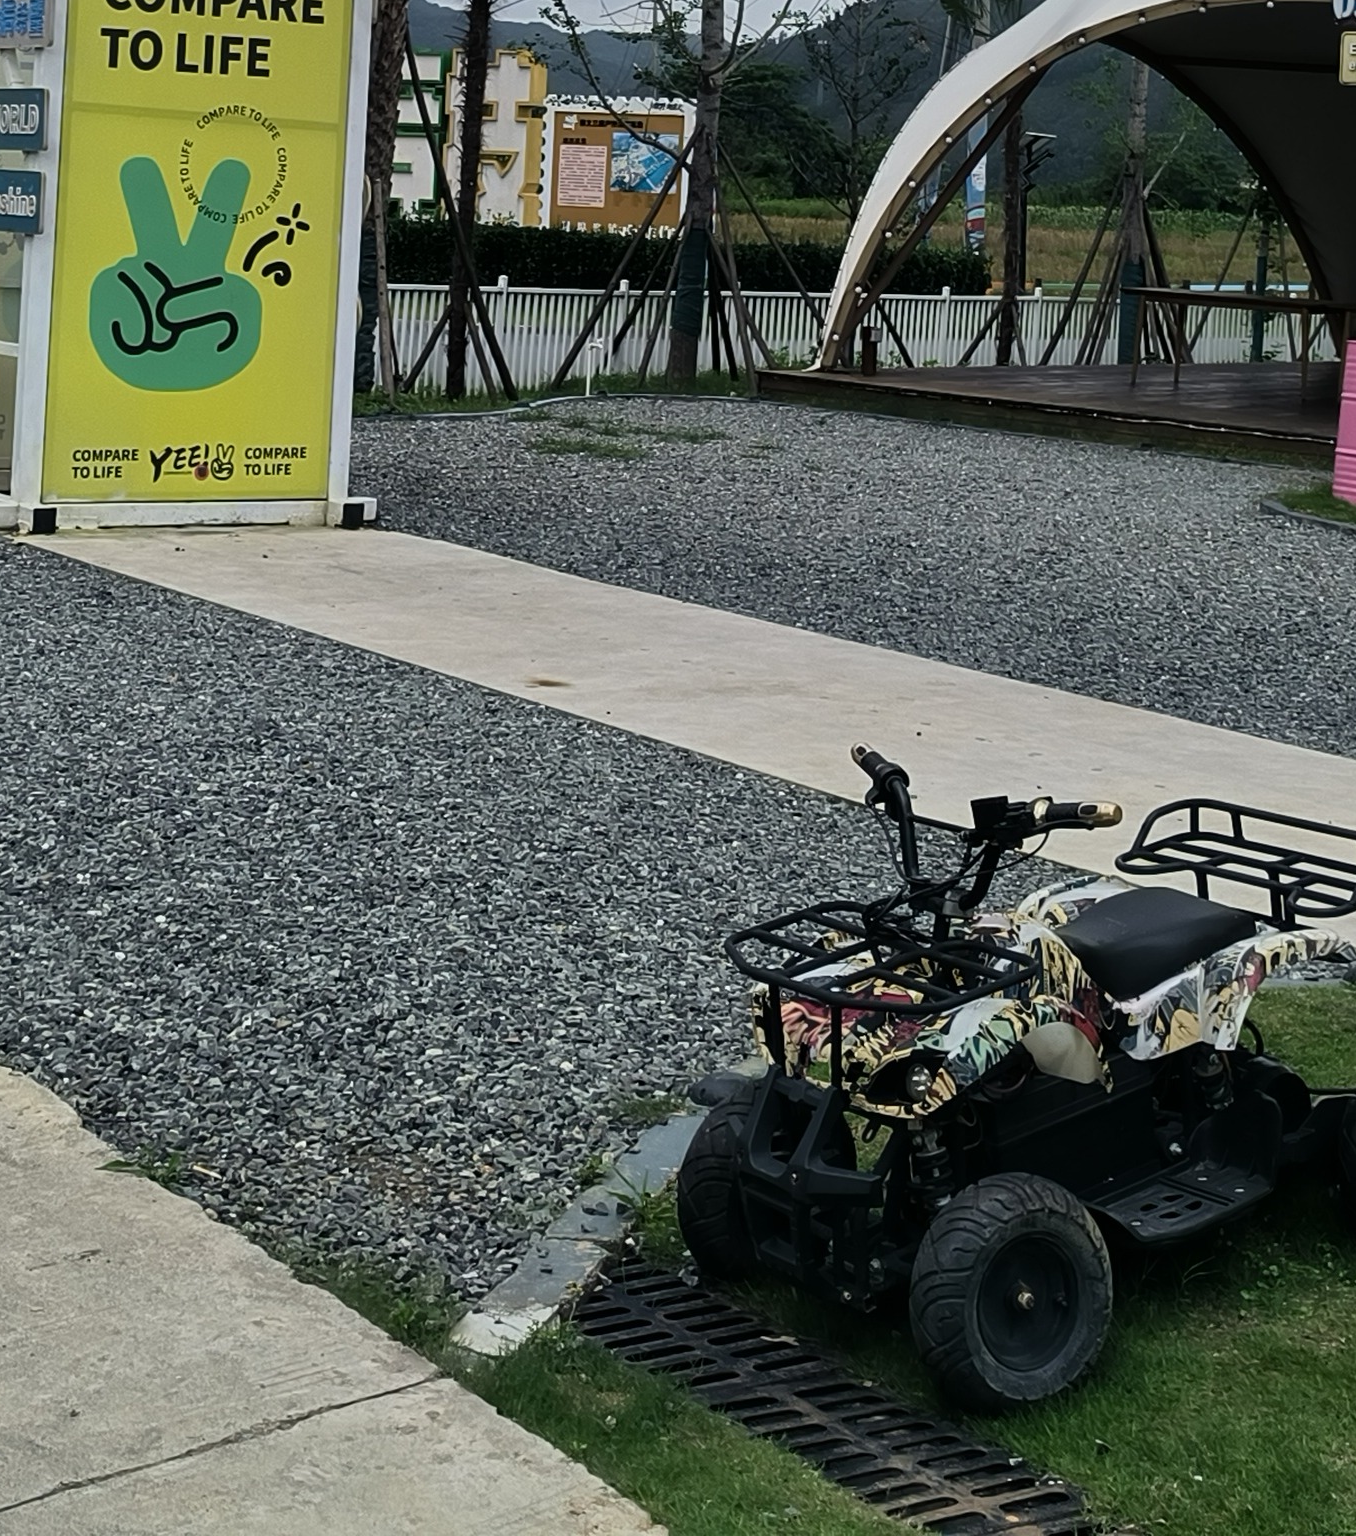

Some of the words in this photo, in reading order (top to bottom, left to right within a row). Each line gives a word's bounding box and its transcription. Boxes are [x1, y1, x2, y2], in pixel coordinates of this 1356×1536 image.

[100, 27, 164, 71] TO
[174, 31, 272, 79] LIFE
[196, 104, 248, 130] COMPARE
[248, 107, 263, 122] TO
[261, 117, 281, 141] LIFE
[179, 138, 194, 165] LIFE
[179, 167, 191, 184] TO
[266, 147, 288, 204] COMPARE
[183, 183, 227, 224] COMPARE
[255, 201, 271, 216] TO
[231, 210, 256, 225] LIFE
[72, 448, 140, 463] COMPARE
[245, 447, 308, 460] COMPARE
[72, 466, 90, 479] TO
[93, 465, 123, 479] LIFE
[244, 463, 262, 476] TO
[264, 463, 292, 476] LIFE
